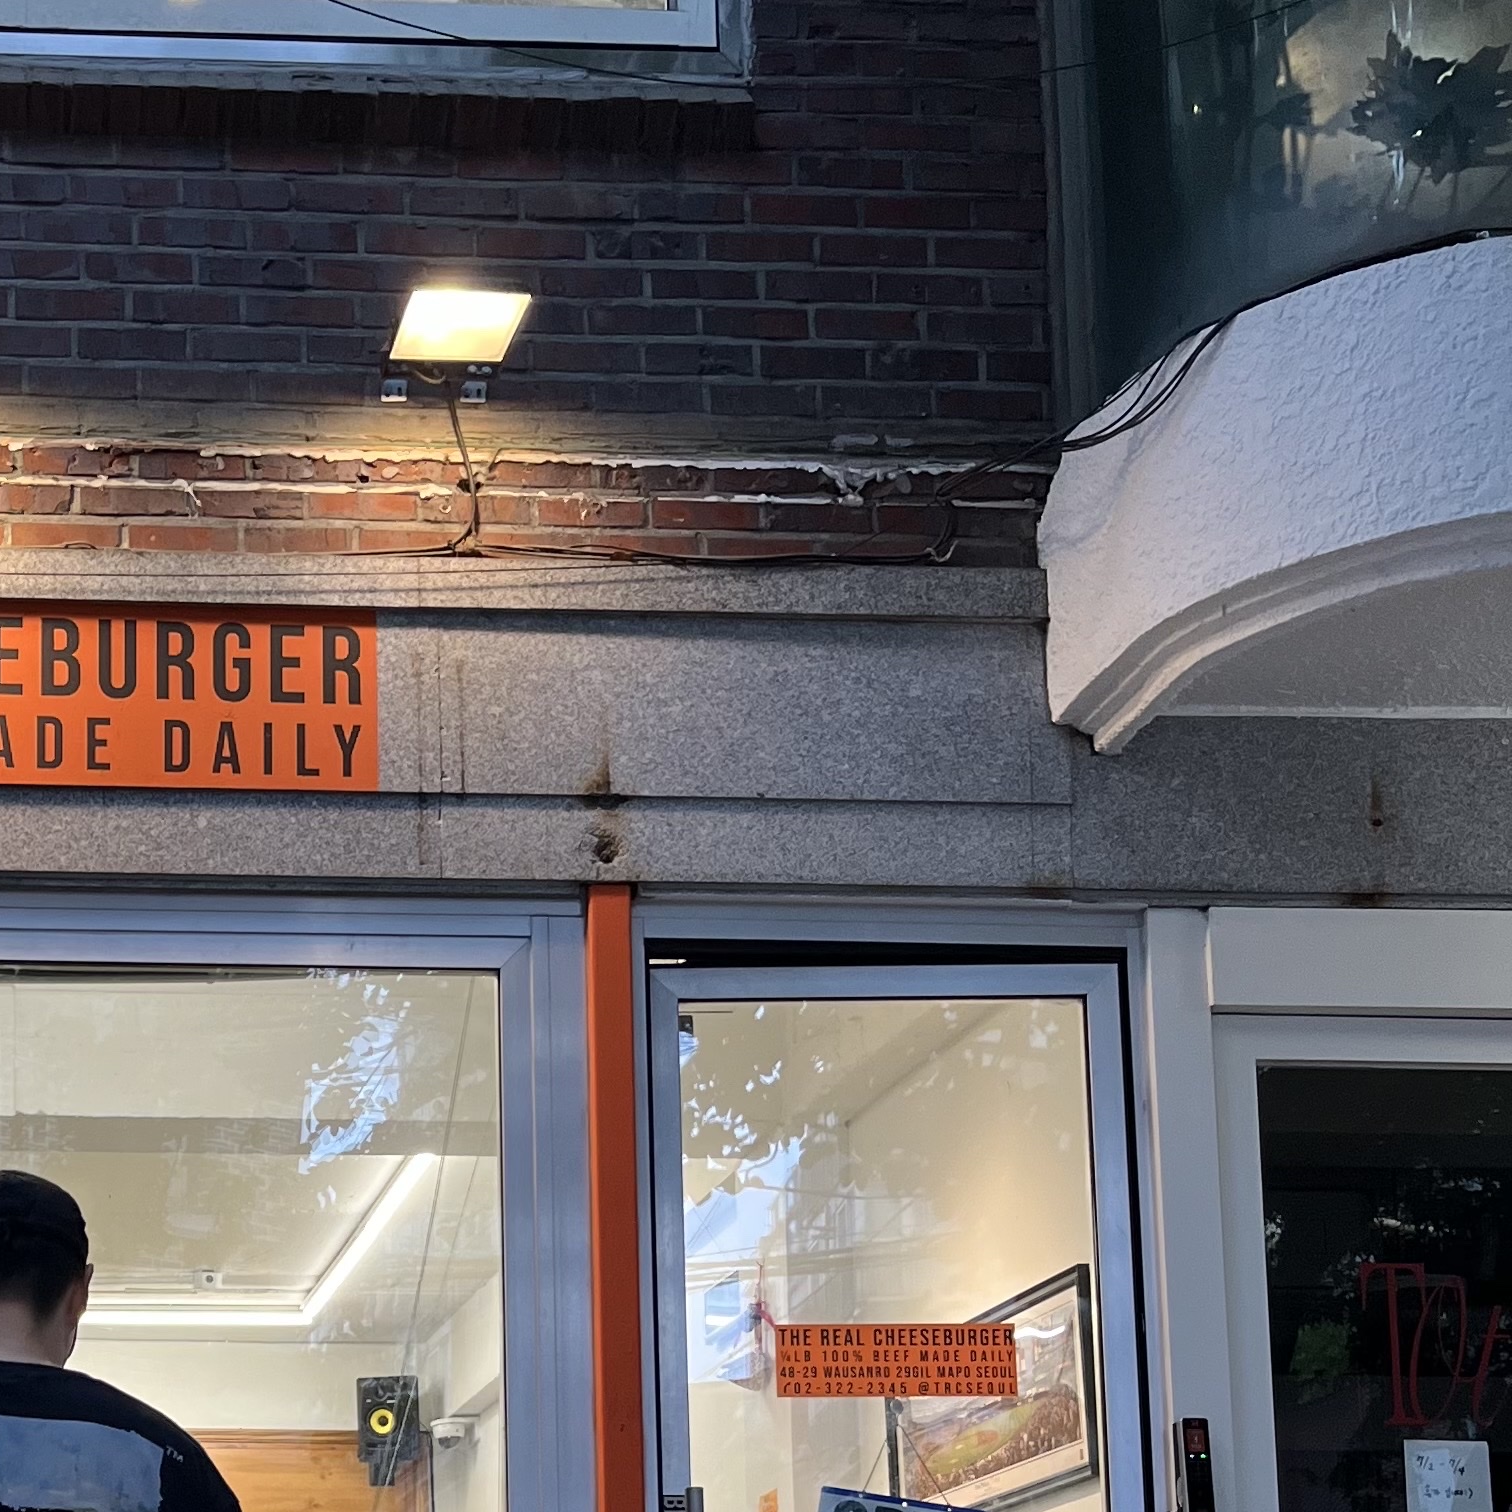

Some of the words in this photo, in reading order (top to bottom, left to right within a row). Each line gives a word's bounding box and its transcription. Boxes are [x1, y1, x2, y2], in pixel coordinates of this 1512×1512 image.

[164, 720, 362, 777] DAILY
[778, 1328, 812, 1346] THE
[820, 1328, 865, 1346] REAL
[873, 1328, 1013, 1347] CHEESEBURGER
[822, 1350, 863, 1362] 100%
[873, 1350, 909, 1362] BEEF
[920, 1350, 960, 1362] MADE
[970, 1350, 1013, 1362] DAILY
[779, 1366, 818, 1379] 48-29
[823, 1366, 890, 1379] WAUSANRO
[896, 1366, 931, 1379] 29GIL
[936, 1366, 971, 1379] MAPO
[976, 1366, 1015, 1379] SEOUL
[918, 1381, 1016, 1395] @TRCSEOUL
